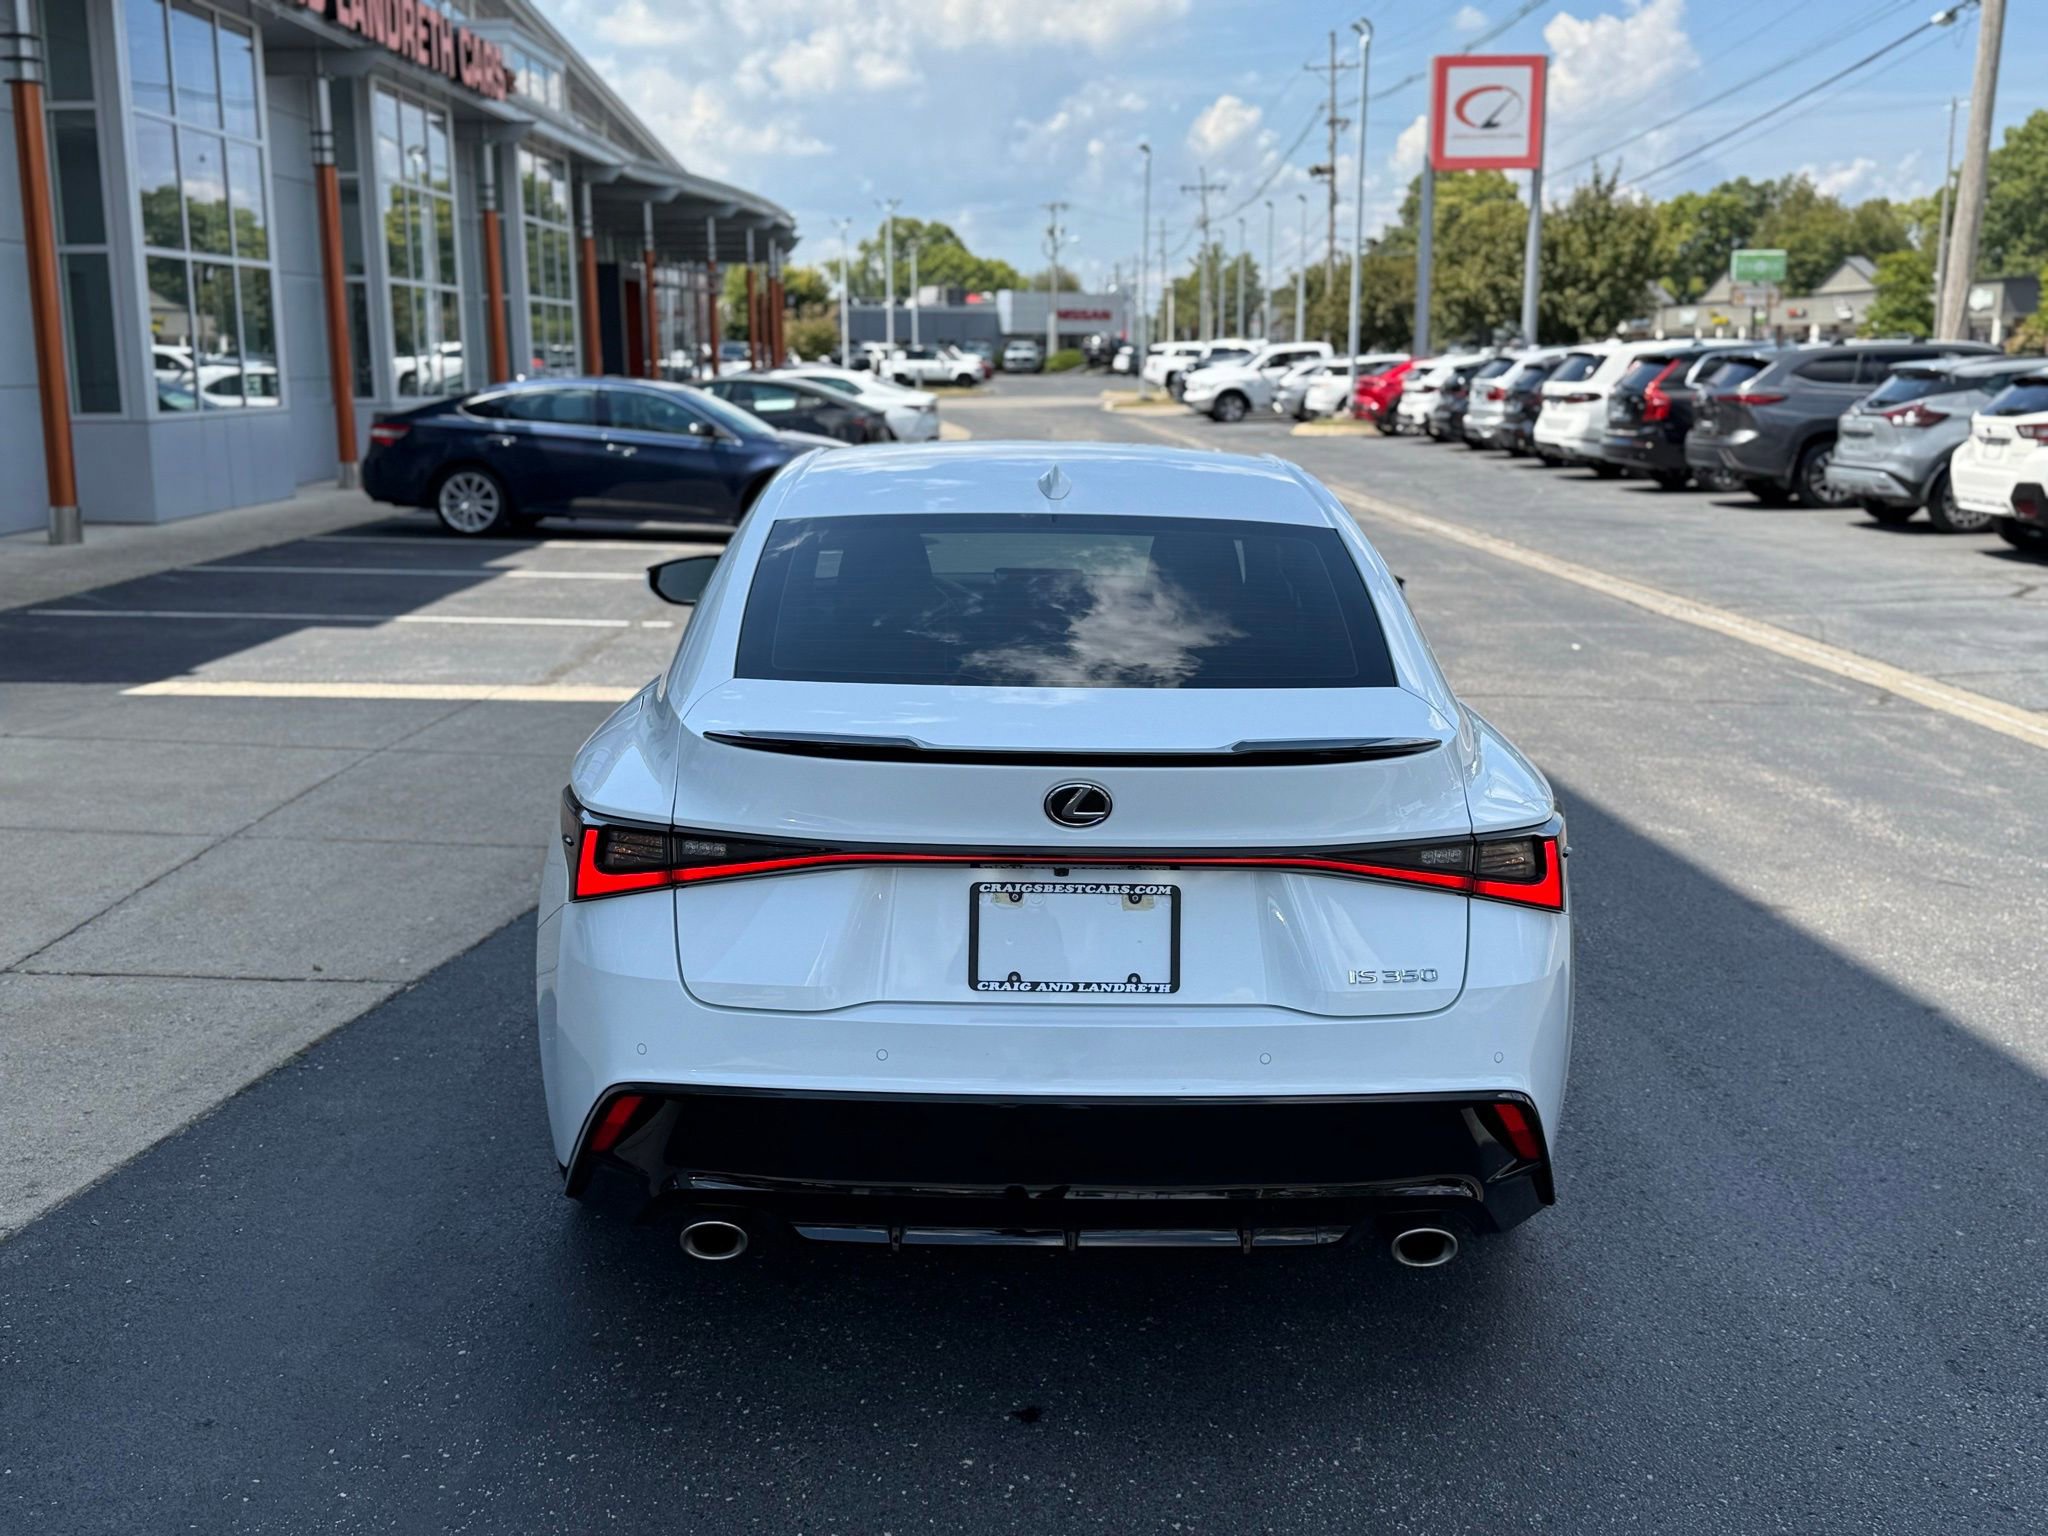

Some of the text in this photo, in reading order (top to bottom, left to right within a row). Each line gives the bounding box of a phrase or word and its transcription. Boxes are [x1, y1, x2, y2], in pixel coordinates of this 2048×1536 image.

[459, 26, 506, 101] CARS
[978, 883, 1172, 895] CRAIGSBESTCARS.COM
[1348, 968, 1438, 984] IS 350
[977, 981, 1171, 993] CRAIG AND LANDRETH
